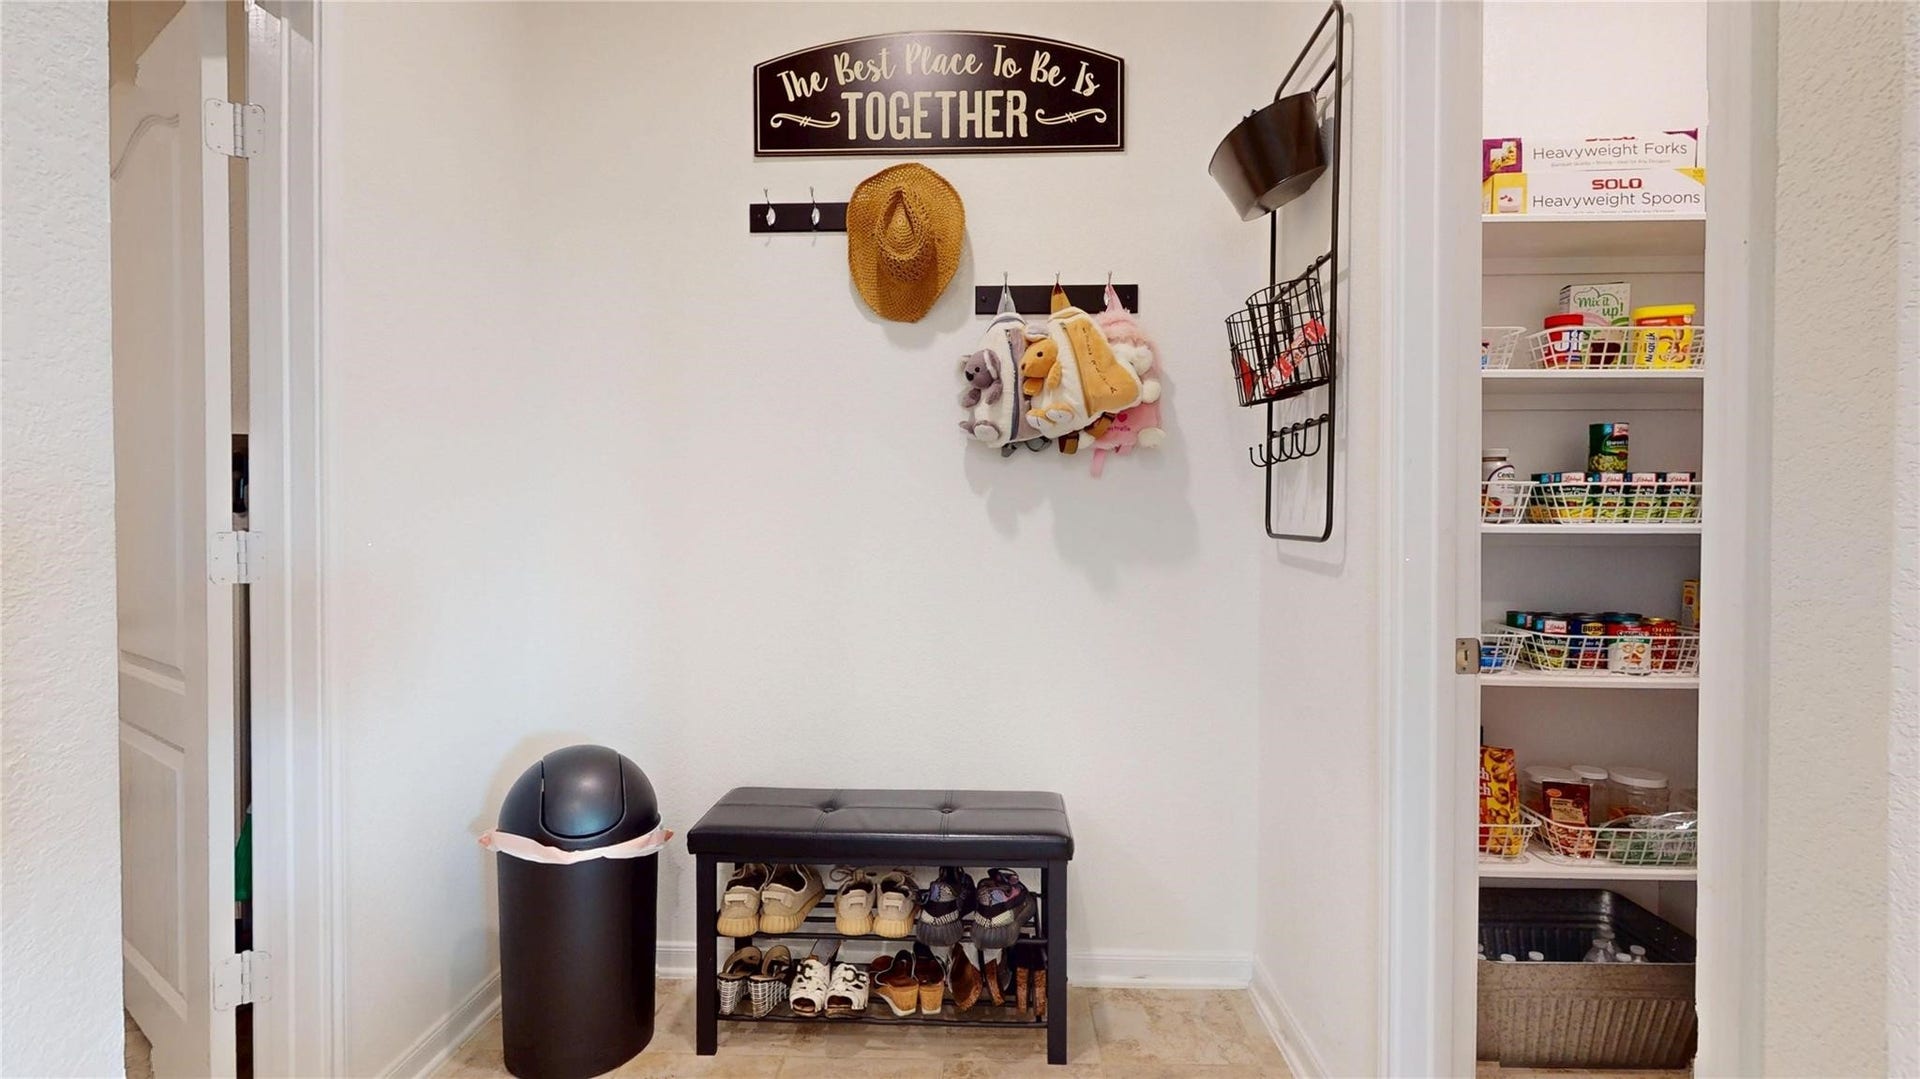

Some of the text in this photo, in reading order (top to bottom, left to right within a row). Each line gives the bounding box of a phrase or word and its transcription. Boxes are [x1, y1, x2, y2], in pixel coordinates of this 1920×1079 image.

[777, 42, 1100, 102] The Best Place To Be Is
[841, 90, 1028, 141] TOGETHER
[1533, 142, 1687, 161] Heavyweight Forks
[1592, 178, 1642, 190] SOLO
[1532, 192, 1701, 209] Heavyweight Spoons
